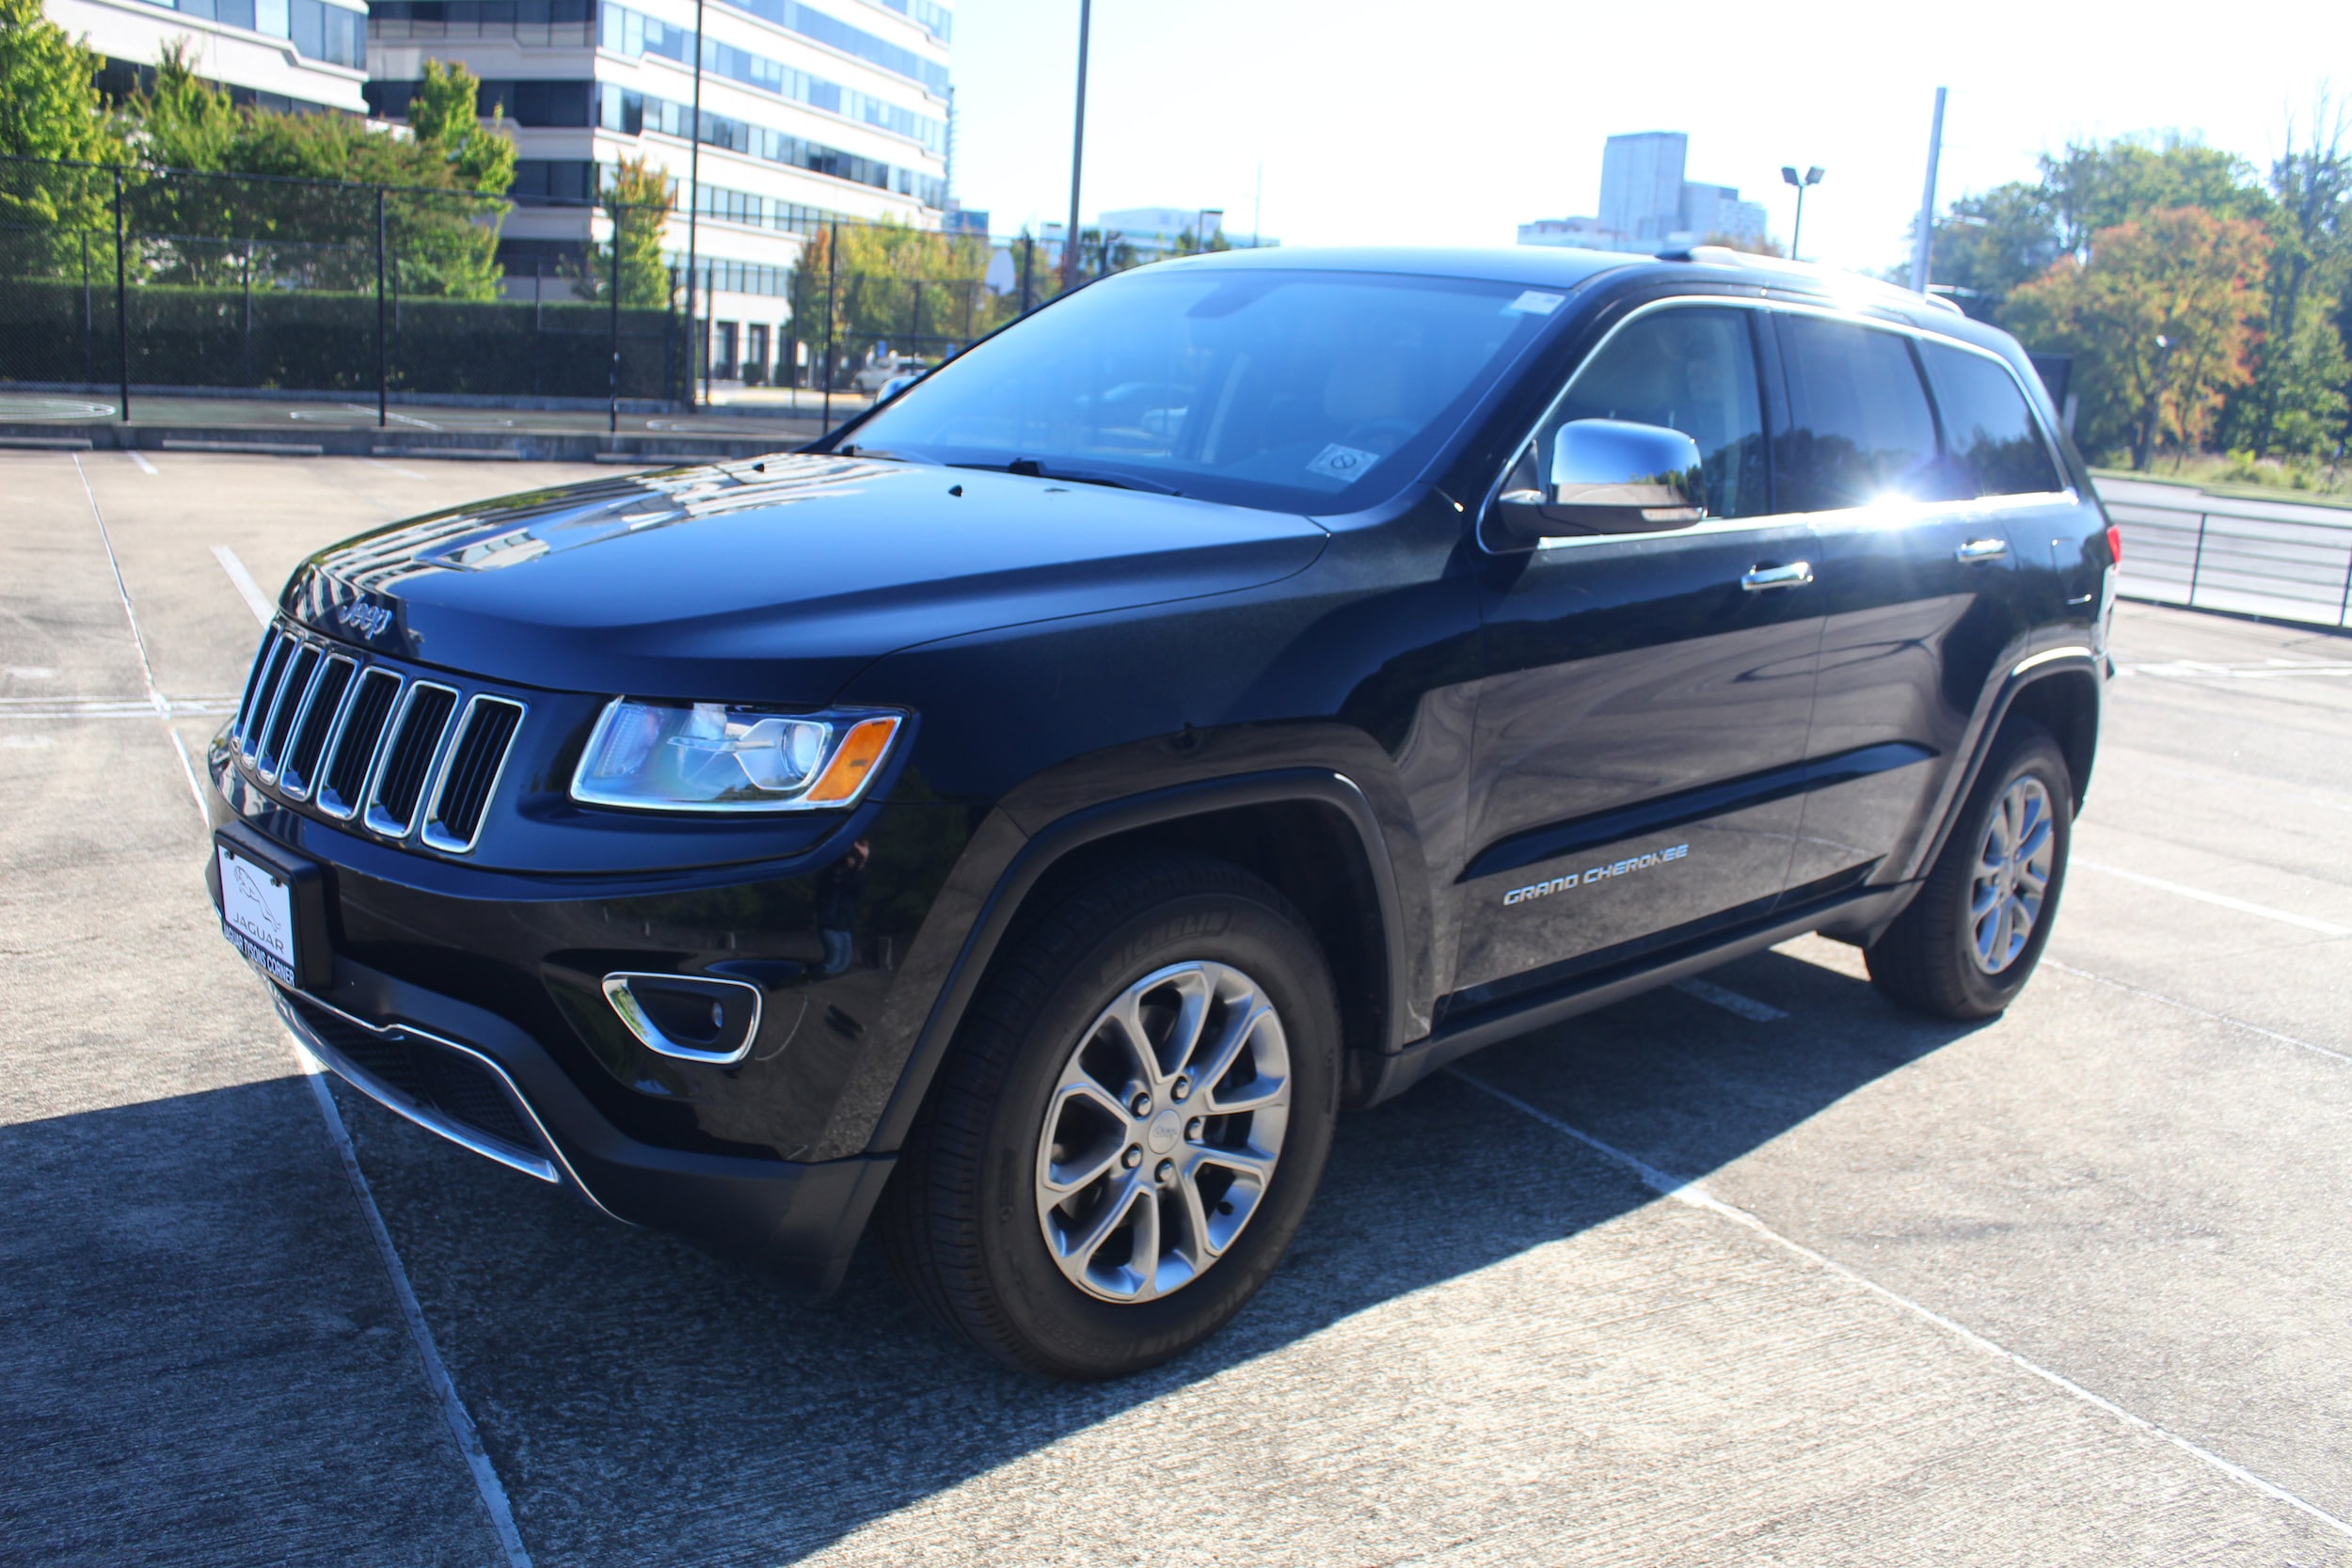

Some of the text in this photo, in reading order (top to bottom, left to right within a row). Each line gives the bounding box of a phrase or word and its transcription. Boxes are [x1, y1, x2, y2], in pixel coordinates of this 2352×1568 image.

[339, 593, 392, 641] Jeep
[1503, 844, 1689, 906] GRAND CHEROKEE
[232, 912, 285, 954] JAGUAR
[266, 955, 295, 987] CORNER
